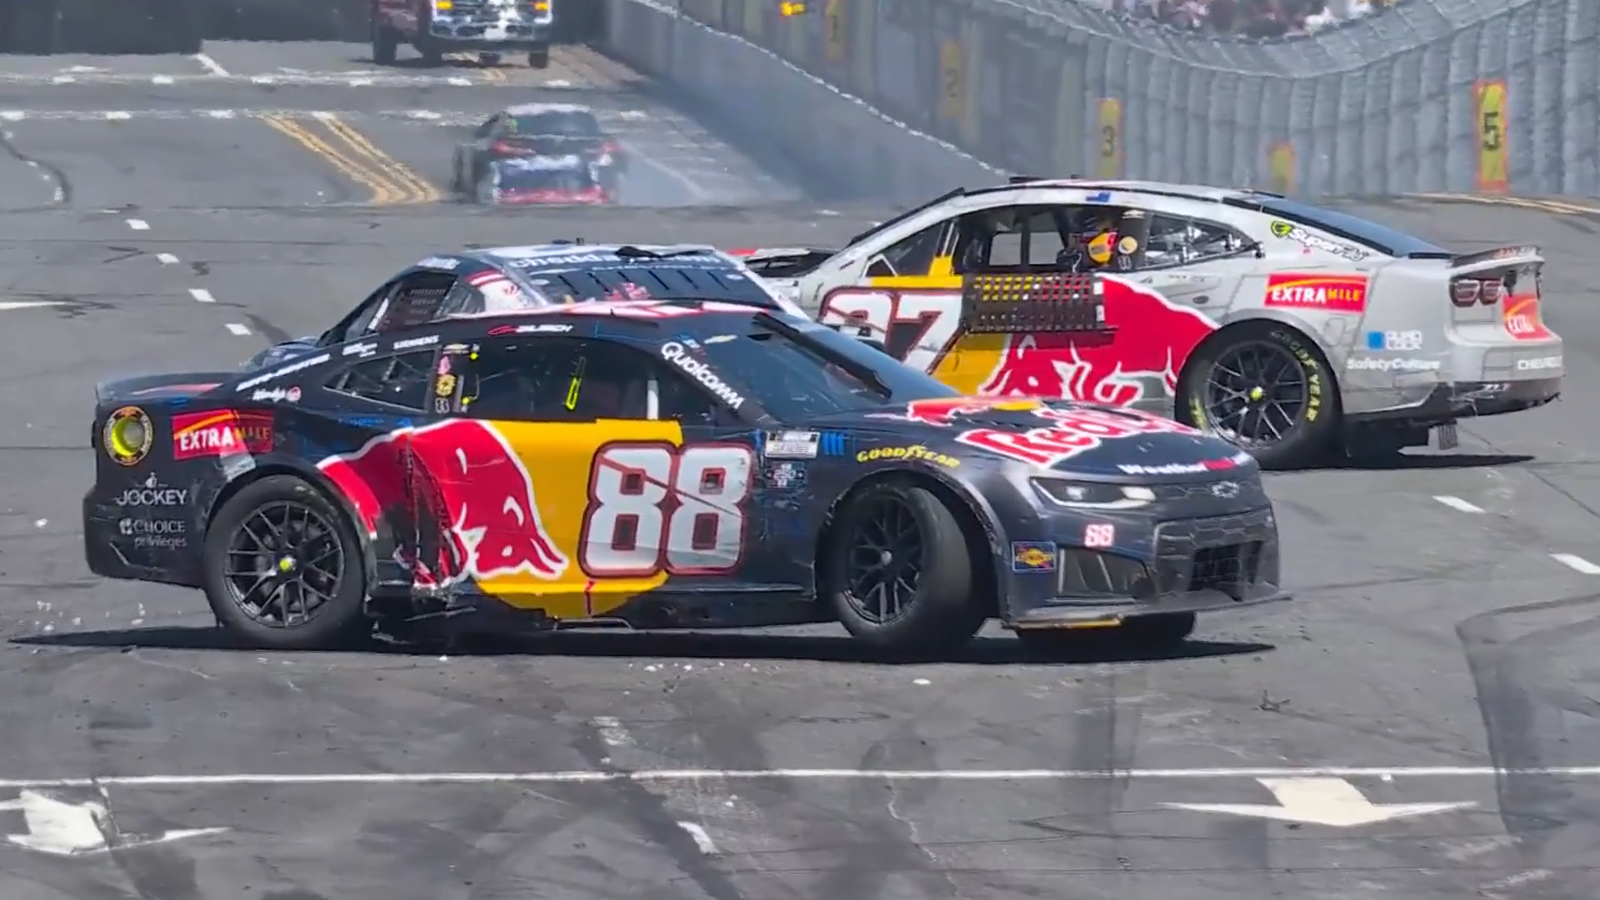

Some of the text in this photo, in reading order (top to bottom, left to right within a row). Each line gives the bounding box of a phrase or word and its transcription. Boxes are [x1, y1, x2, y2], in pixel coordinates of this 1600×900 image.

[1103, 125, 1116, 157] 3
[1484, 111, 1500, 151] 5
[1271, 286, 1361, 304] EXTRA MILE
[661, 341, 746, 410] Qualcomm
[180, 426, 271, 452] EXTRA MILE
[856, 444, 961, 469] GOODYEAR
[115, 489, 187, 506] JOCKEY
[579, 440, 752, 578] 88
[133, 519, 186, 533] CHOICE
[133, 534, 188, 550] privileges
